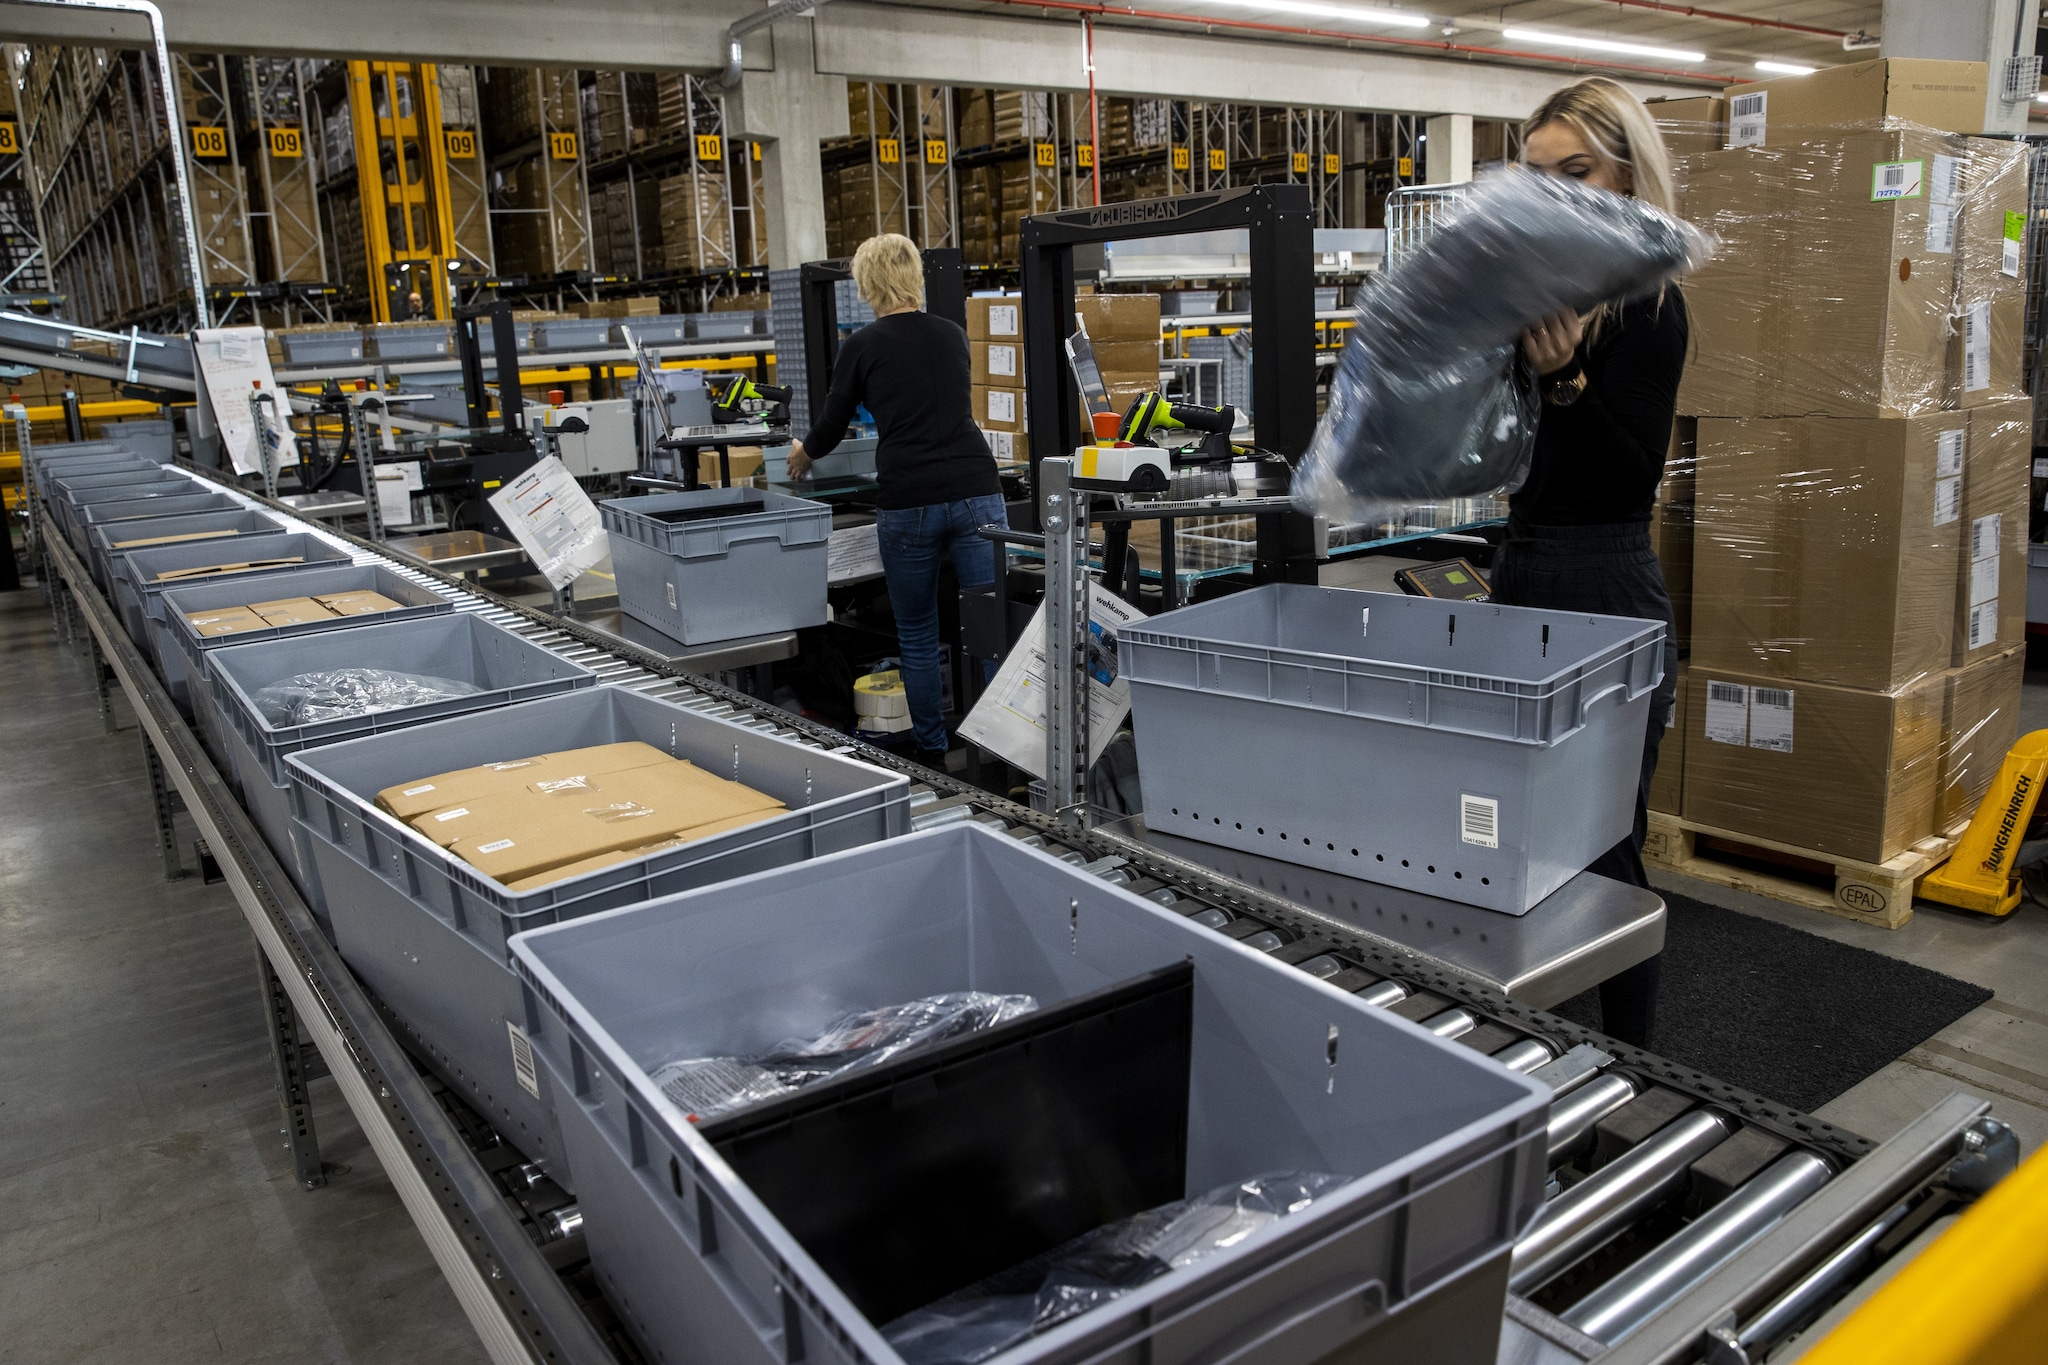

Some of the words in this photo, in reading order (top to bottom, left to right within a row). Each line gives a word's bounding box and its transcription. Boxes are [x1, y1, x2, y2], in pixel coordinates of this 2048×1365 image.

[197, 132, 222, 151] 08
[274, 133, 297, 152] 09
[450, 136, 471, 154] 09
[554, 137, 573, 154] 10
[700, 139, 717, 156] 10
[882, 144, 897, 159] 11
[929, 145, 944, 159] 12
[1039, 148, 1052, 162] 12
[1080, 149, 1093, 163] 13
[1176, 152, 1187, 165] 13
[1212, 154, 1223, 167] 14
[1295, 156, 1307, 169] 14
[1327, 157, 1338, 171] 15
[1401, 161, 1411, 174] 15
[1100, 200, 1179, 225] CUBISCAN
[1096, 596, 1130, 621] wehkamp
[1987, 774, 2032, 873] JUNGHEINRICH
[1846, 888, 1879, 909] EPAL
